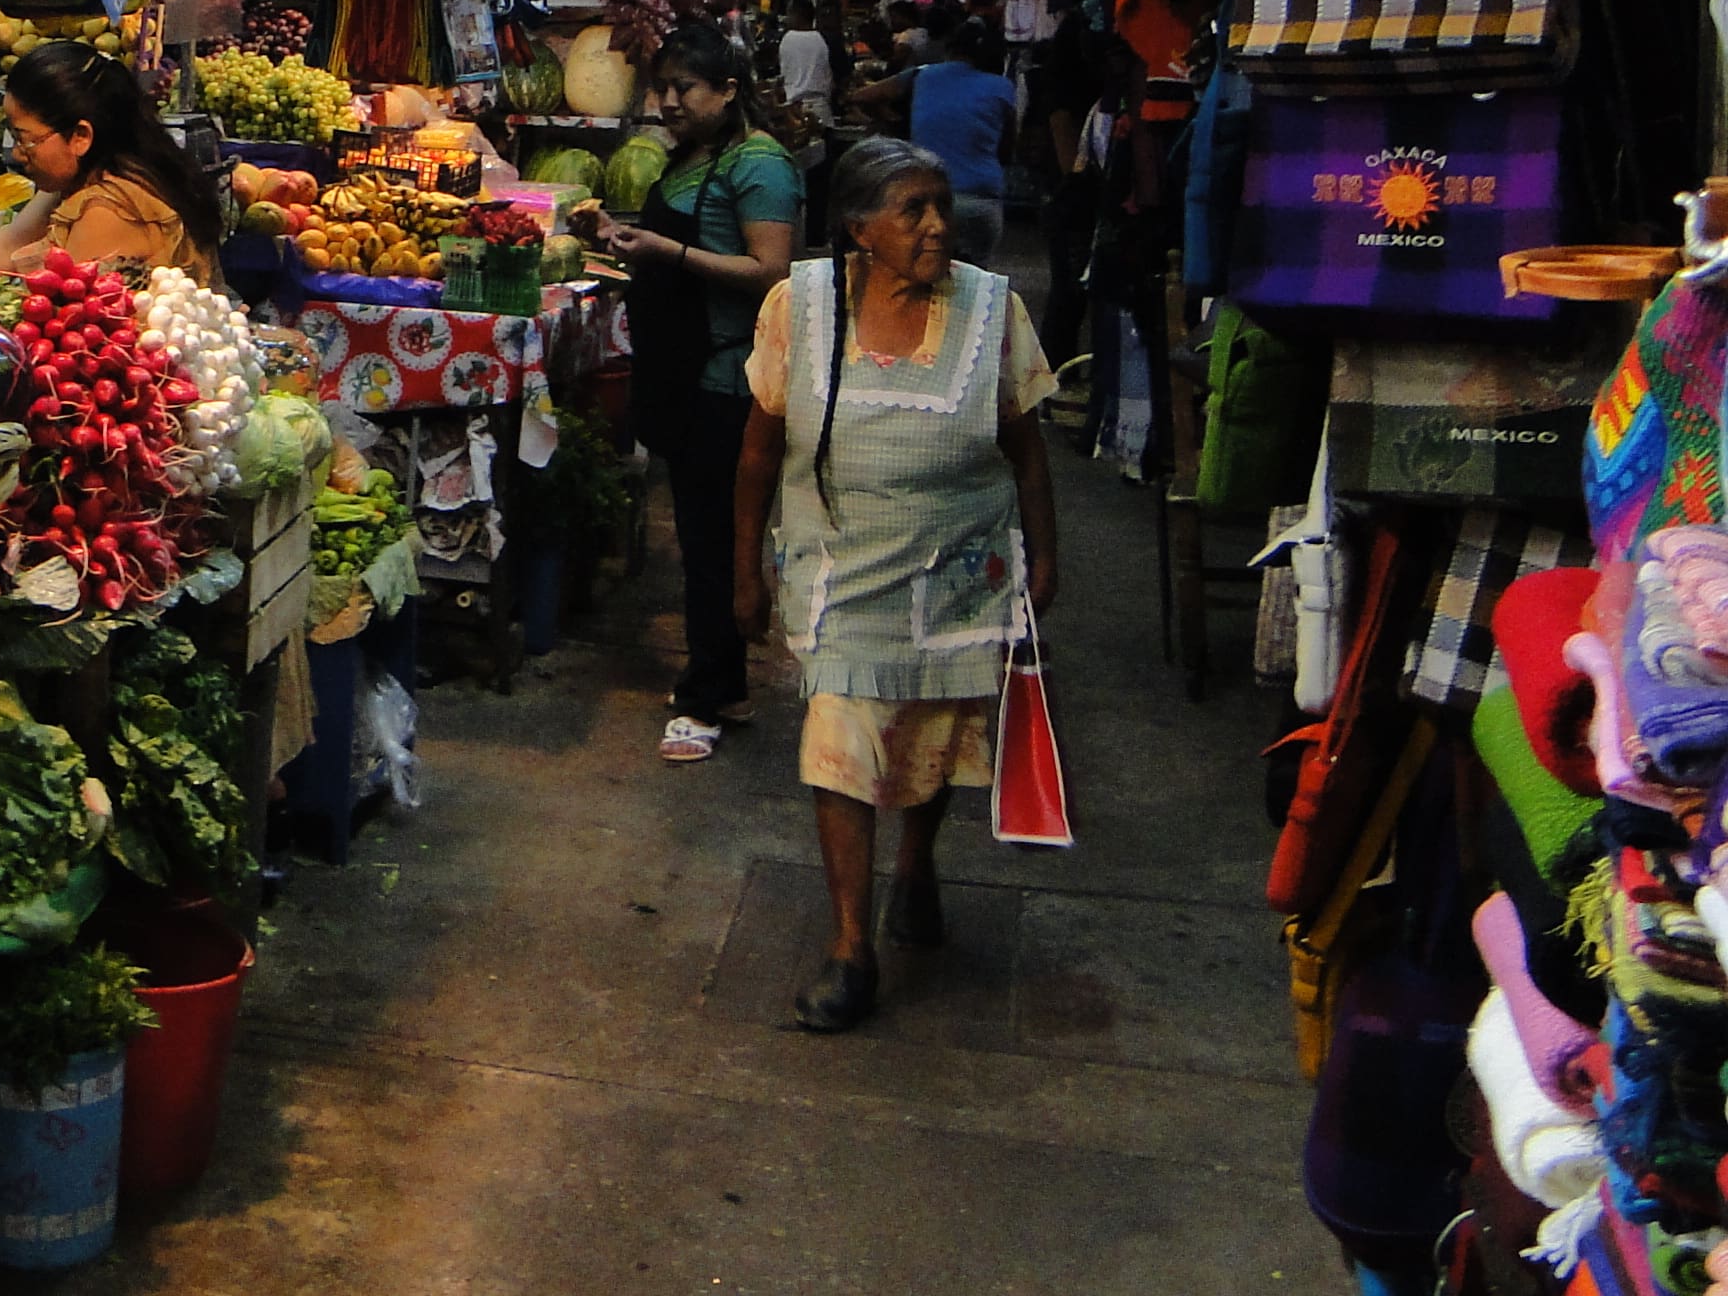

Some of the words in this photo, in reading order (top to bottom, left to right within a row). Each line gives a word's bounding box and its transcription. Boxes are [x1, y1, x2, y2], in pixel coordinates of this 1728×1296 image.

[1365, 146, 1447, 170] OAXACA
[1358, 233, 1445, 247] MEXICO
[1451, 427, 1559, 444] MEXICO
